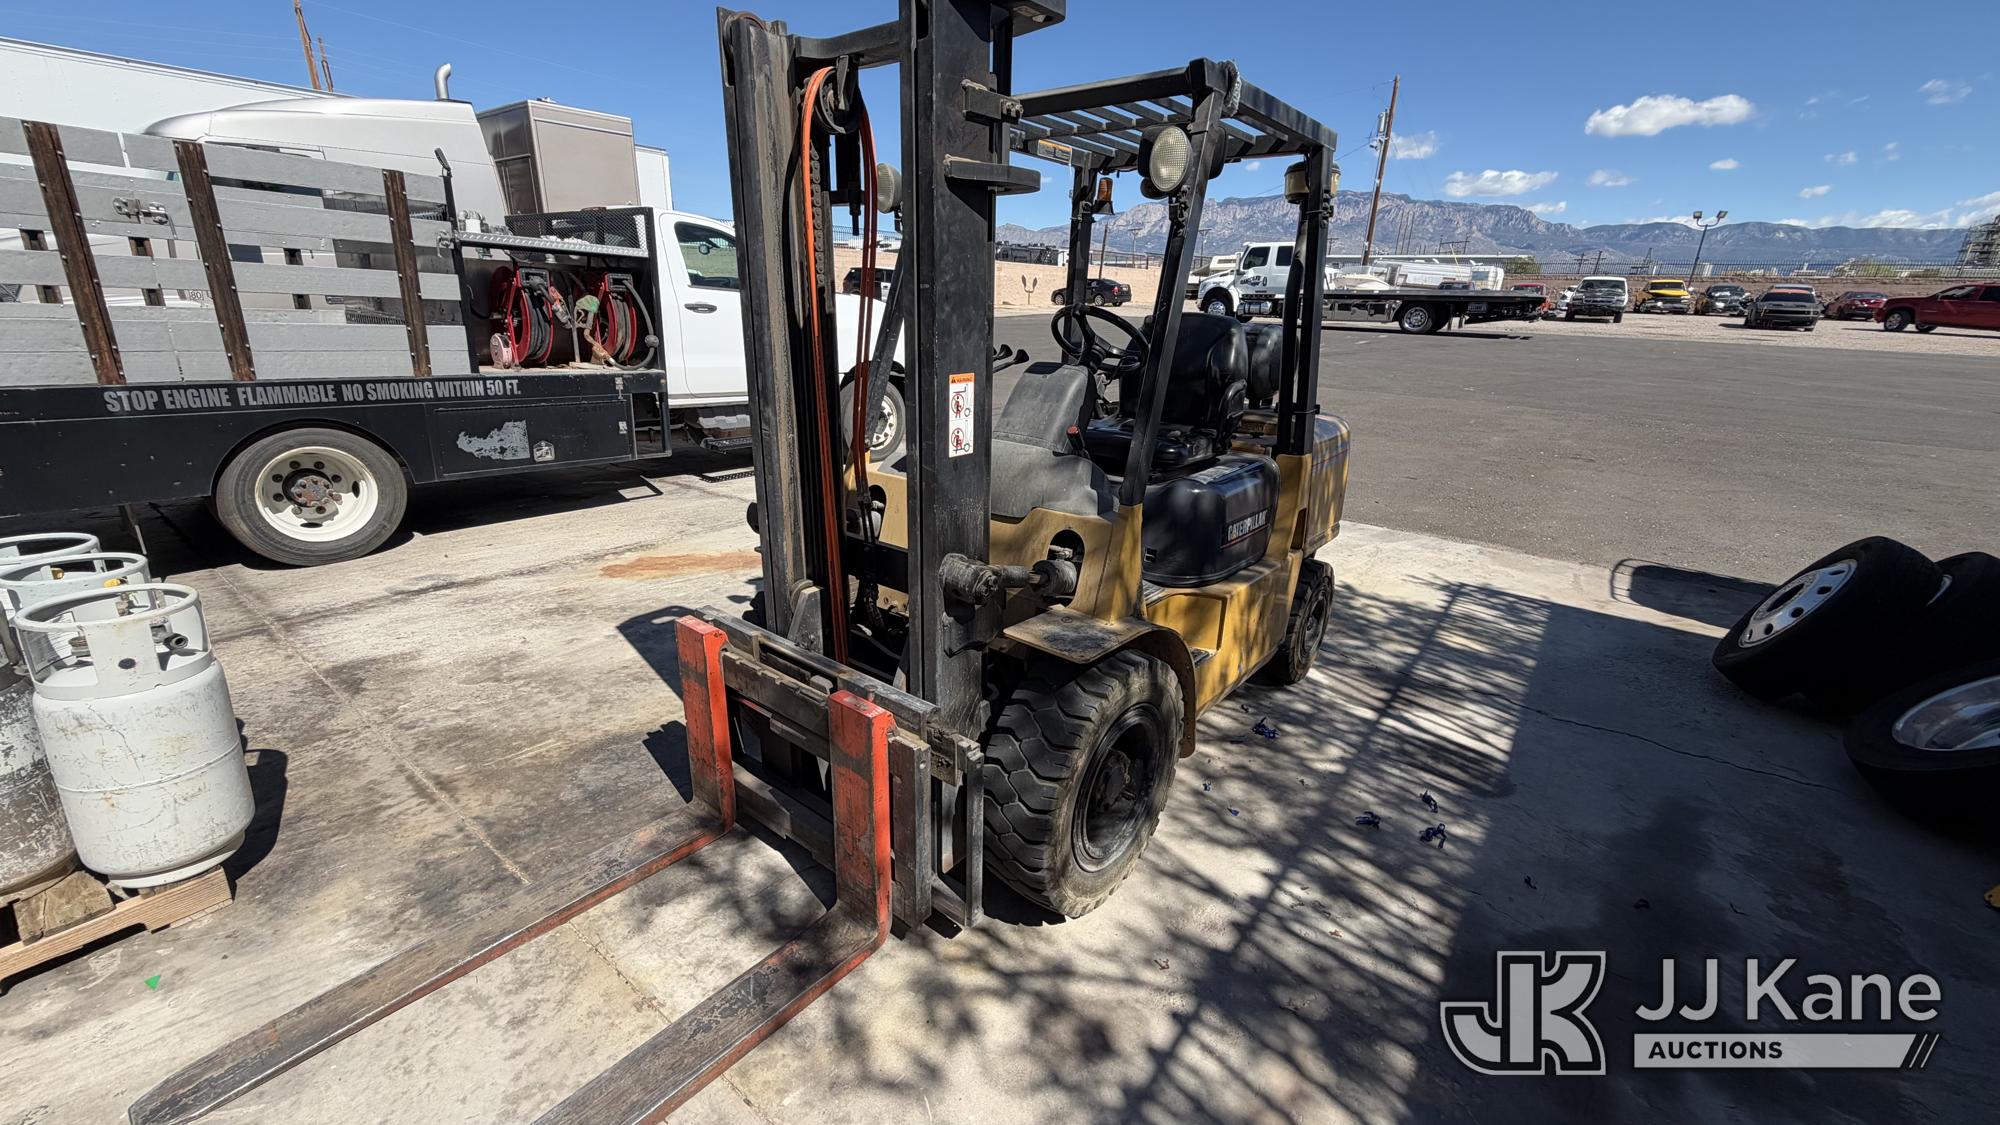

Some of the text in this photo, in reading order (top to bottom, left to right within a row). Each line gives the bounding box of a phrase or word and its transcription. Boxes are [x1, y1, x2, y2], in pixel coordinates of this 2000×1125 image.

[103, 379, 521, 412] STOP ENGINE FLAMMABLE NO SMOKING WITHIN 50 FT.
[1227, 509, 1268, 541] CATERPILLAR
